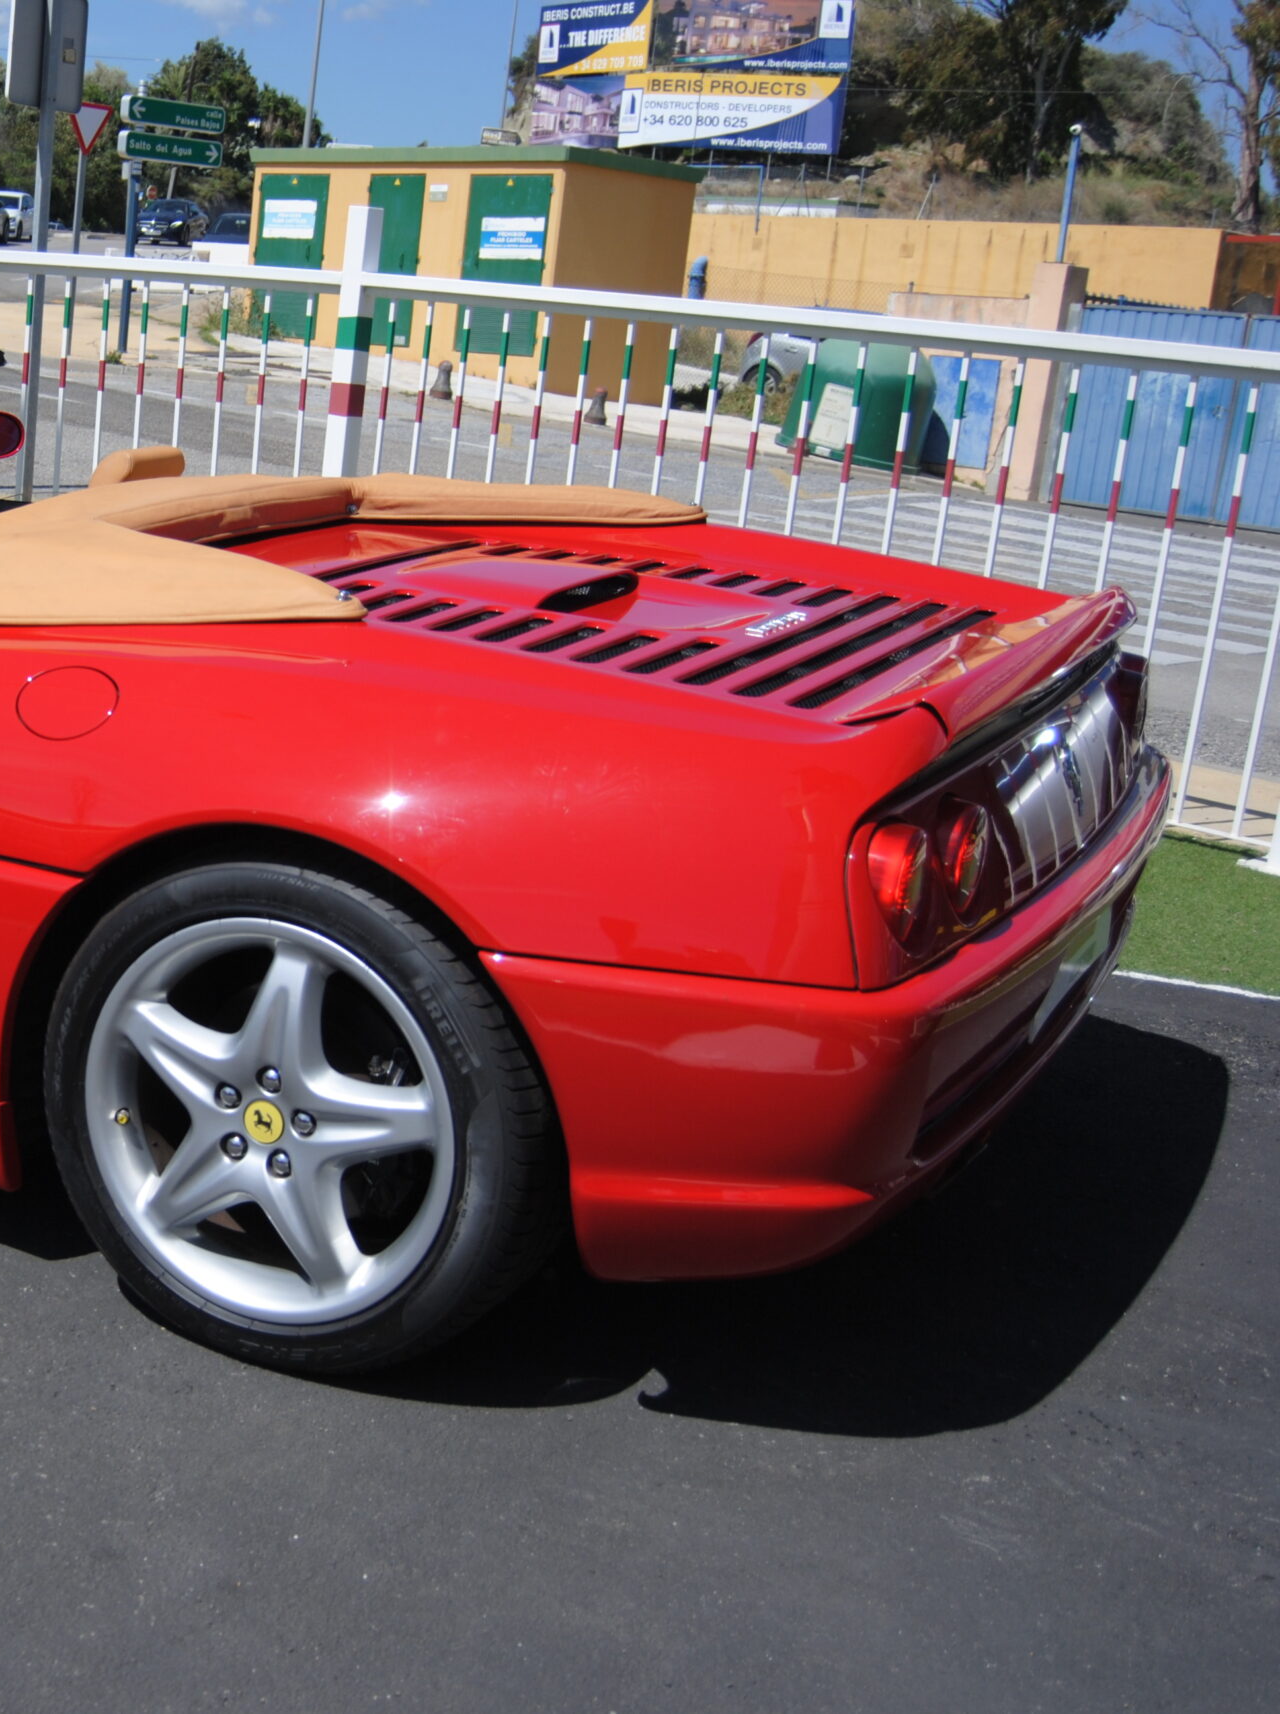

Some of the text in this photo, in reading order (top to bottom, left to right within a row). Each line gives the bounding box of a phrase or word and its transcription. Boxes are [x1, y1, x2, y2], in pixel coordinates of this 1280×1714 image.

[543, 2, 635, 22] IBERIS CONSTRUCT.BE
[588, 25, 646, 46] DIFFERENCE
[743, 59, 848, 70] www.iberisprojects.com
[647, 79, 807, 96] IBERIS PROJECTS
[644, 100, 720, 110] CONSTRUCTORS
[728, 103, 793, 113] DEVELOPERS
[200, 118, 221, 130] Bajos
[643, 114, 665, 125] +34
[668, 114, 693, 126] 620
[695, 115, 720, 127] 800
[723, 116, 748, 128] 625
[129, 139, 192, 157] Salto del Agua
[710, 138, 828, 151] www.iberisprojects.com
